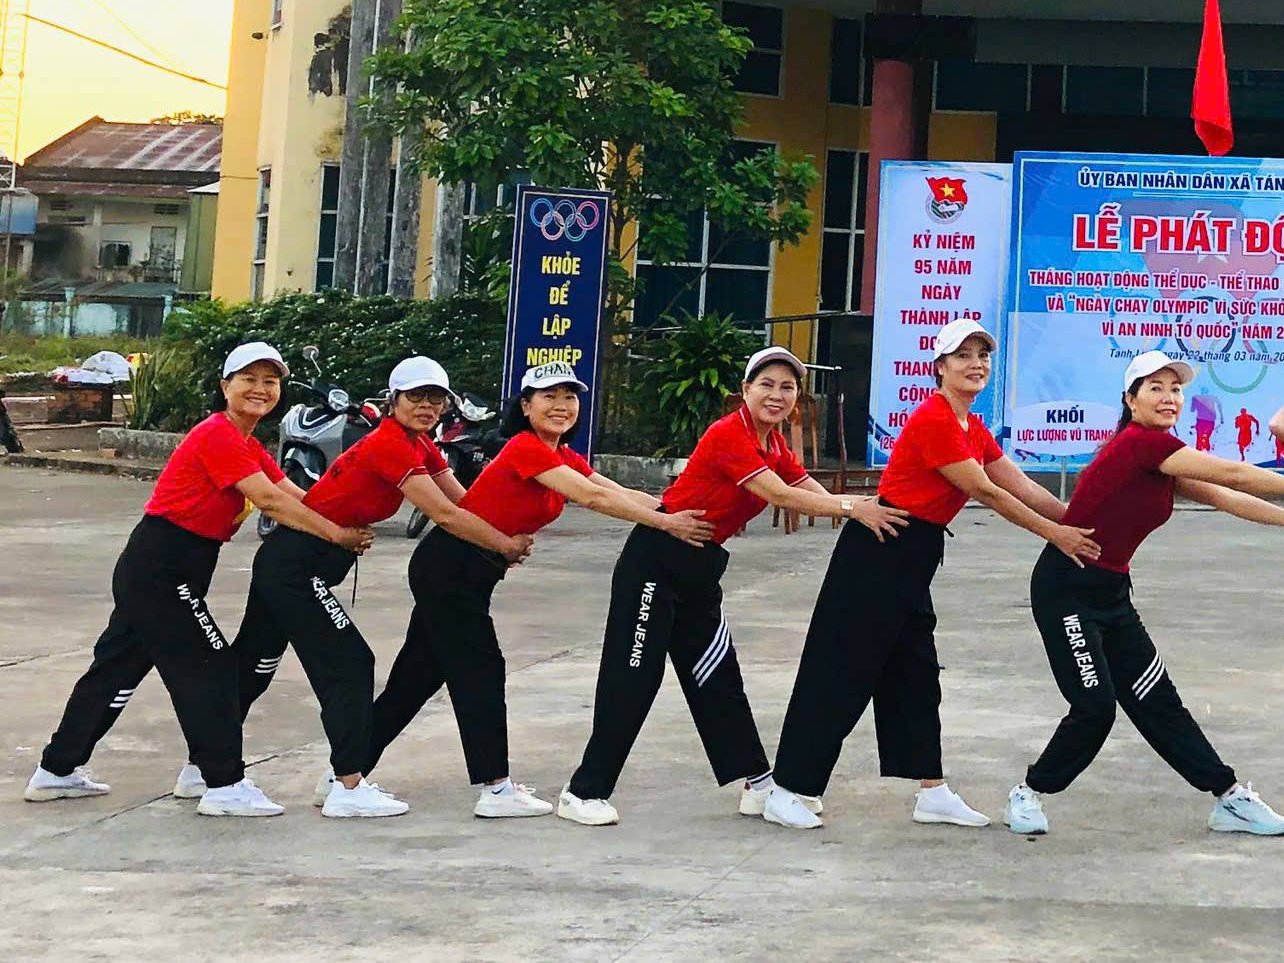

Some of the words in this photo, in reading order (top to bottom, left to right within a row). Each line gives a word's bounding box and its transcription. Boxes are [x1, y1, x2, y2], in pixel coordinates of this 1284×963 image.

[1080, 167, 1101, 186] ỦY
[1105, 173, 1138, 187] BAN
[1142, 171, 1189, 189] NHÂN
[1192, 173, 1225, 189] DÂN
[1229, 175, 1251, 191] XÃ
[1074, 204, 1120, 250] LỄ
[1132, 211, 1234, 253] PHÁT
[913, 229, 932, 249] KỶ
[936, 231, 975, 253] NIỆM
[541, 250, 581, 276] KHỎE
[914, 259, 932, 275] 95
[936, 256, 972, 275] NĂM
[921, 282, 962, 300] NGÀY
[1029, 267, 1073, 286] THÁNG
[1076, 272, 1111, 290] HOẠT
[1113, 271, 1150, 290] ĐỘNG
[1153, 268, 1178, 288] THỂ
[1181, 275, 1207, 290] DỤC
[1219, 270, 1245, 290] THỂ
[1247, 276, 1280, 291] THAO
[549, 279, 571, 306] ĐỂ
[900, 306, 949, 326] THÀNH
[1047, 294, 1065, 311] VÀ
[1114, 299, 1149, 315] CHẠY
[1152, 299, 1209, 314] OLYMPIC
[1230, 298, 1257, 316] SỨC
[542, 313, 572, 340] LẬP
[1102, 316, 1114, 336] VÌ
[1118, 322, 1137, 337] AN
[1140, 323, 1173, 337] NINH
[1188, 350, 1201, 360] 22
[1233, 350, 1247, 361] 03
[894, 360, 936, 377] THAN
[1046, 404, 1084, 424] KHỐI
[1017, 428, 1035, 444] LỰC
[1036, 428, 1067, 444] LƯỢNG
[321, 597, 350, 629] JEANS
[637, 582, 657, 622] WEAR
[194, 611, 224, 650] JEANS
[1062, 613, 1086, 650] WEAR
[629, 623, 647, 668] JEANS
[1073, 651, 1099, 688] JEANS
